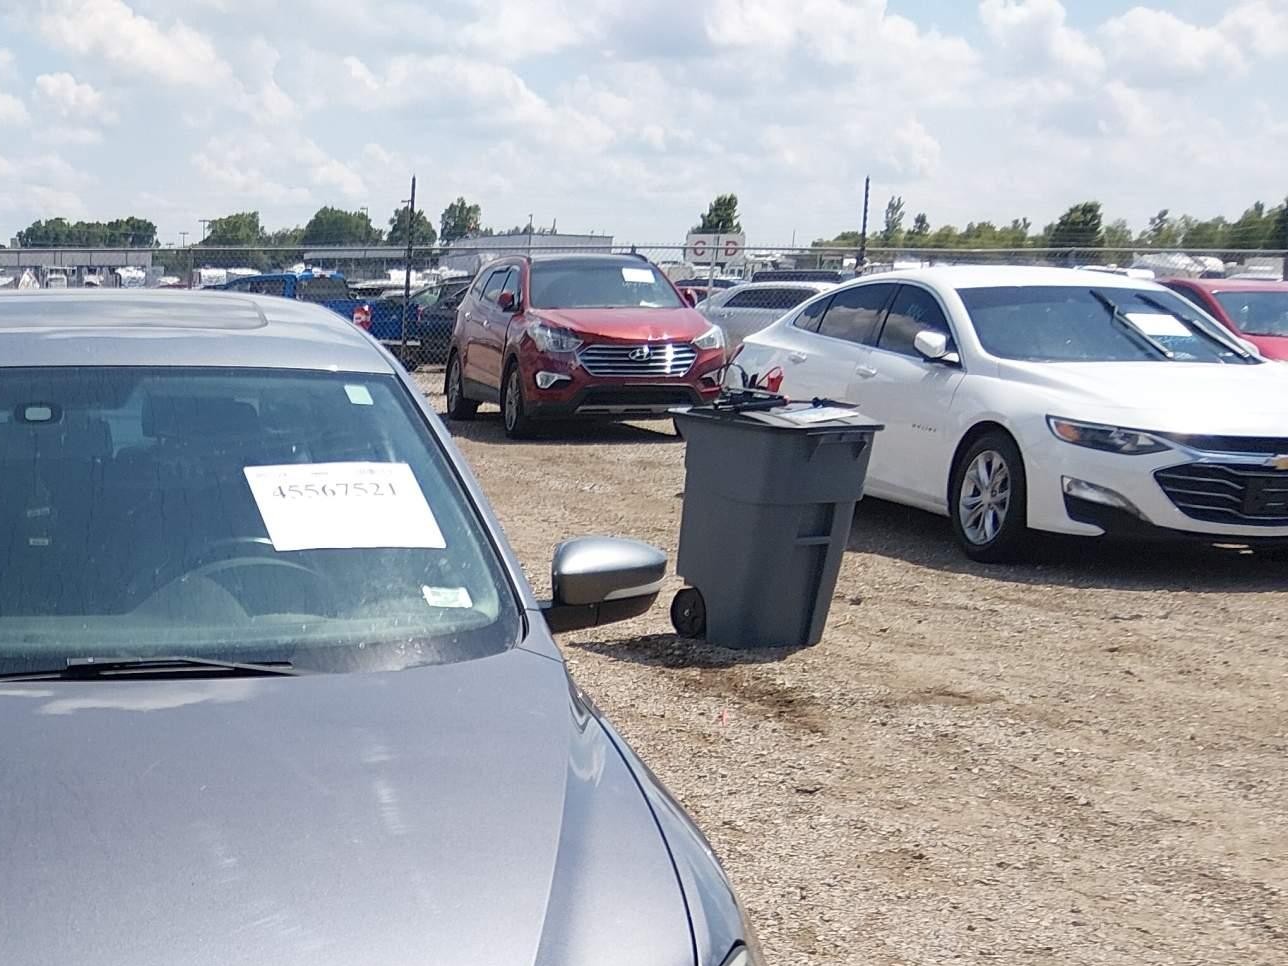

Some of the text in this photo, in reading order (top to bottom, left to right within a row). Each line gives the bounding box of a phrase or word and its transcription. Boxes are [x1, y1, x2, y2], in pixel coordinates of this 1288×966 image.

[693, 240, 706, 256] C
[724, 240, 738, 256] D
[272, 482, 397, 499] 45567521
